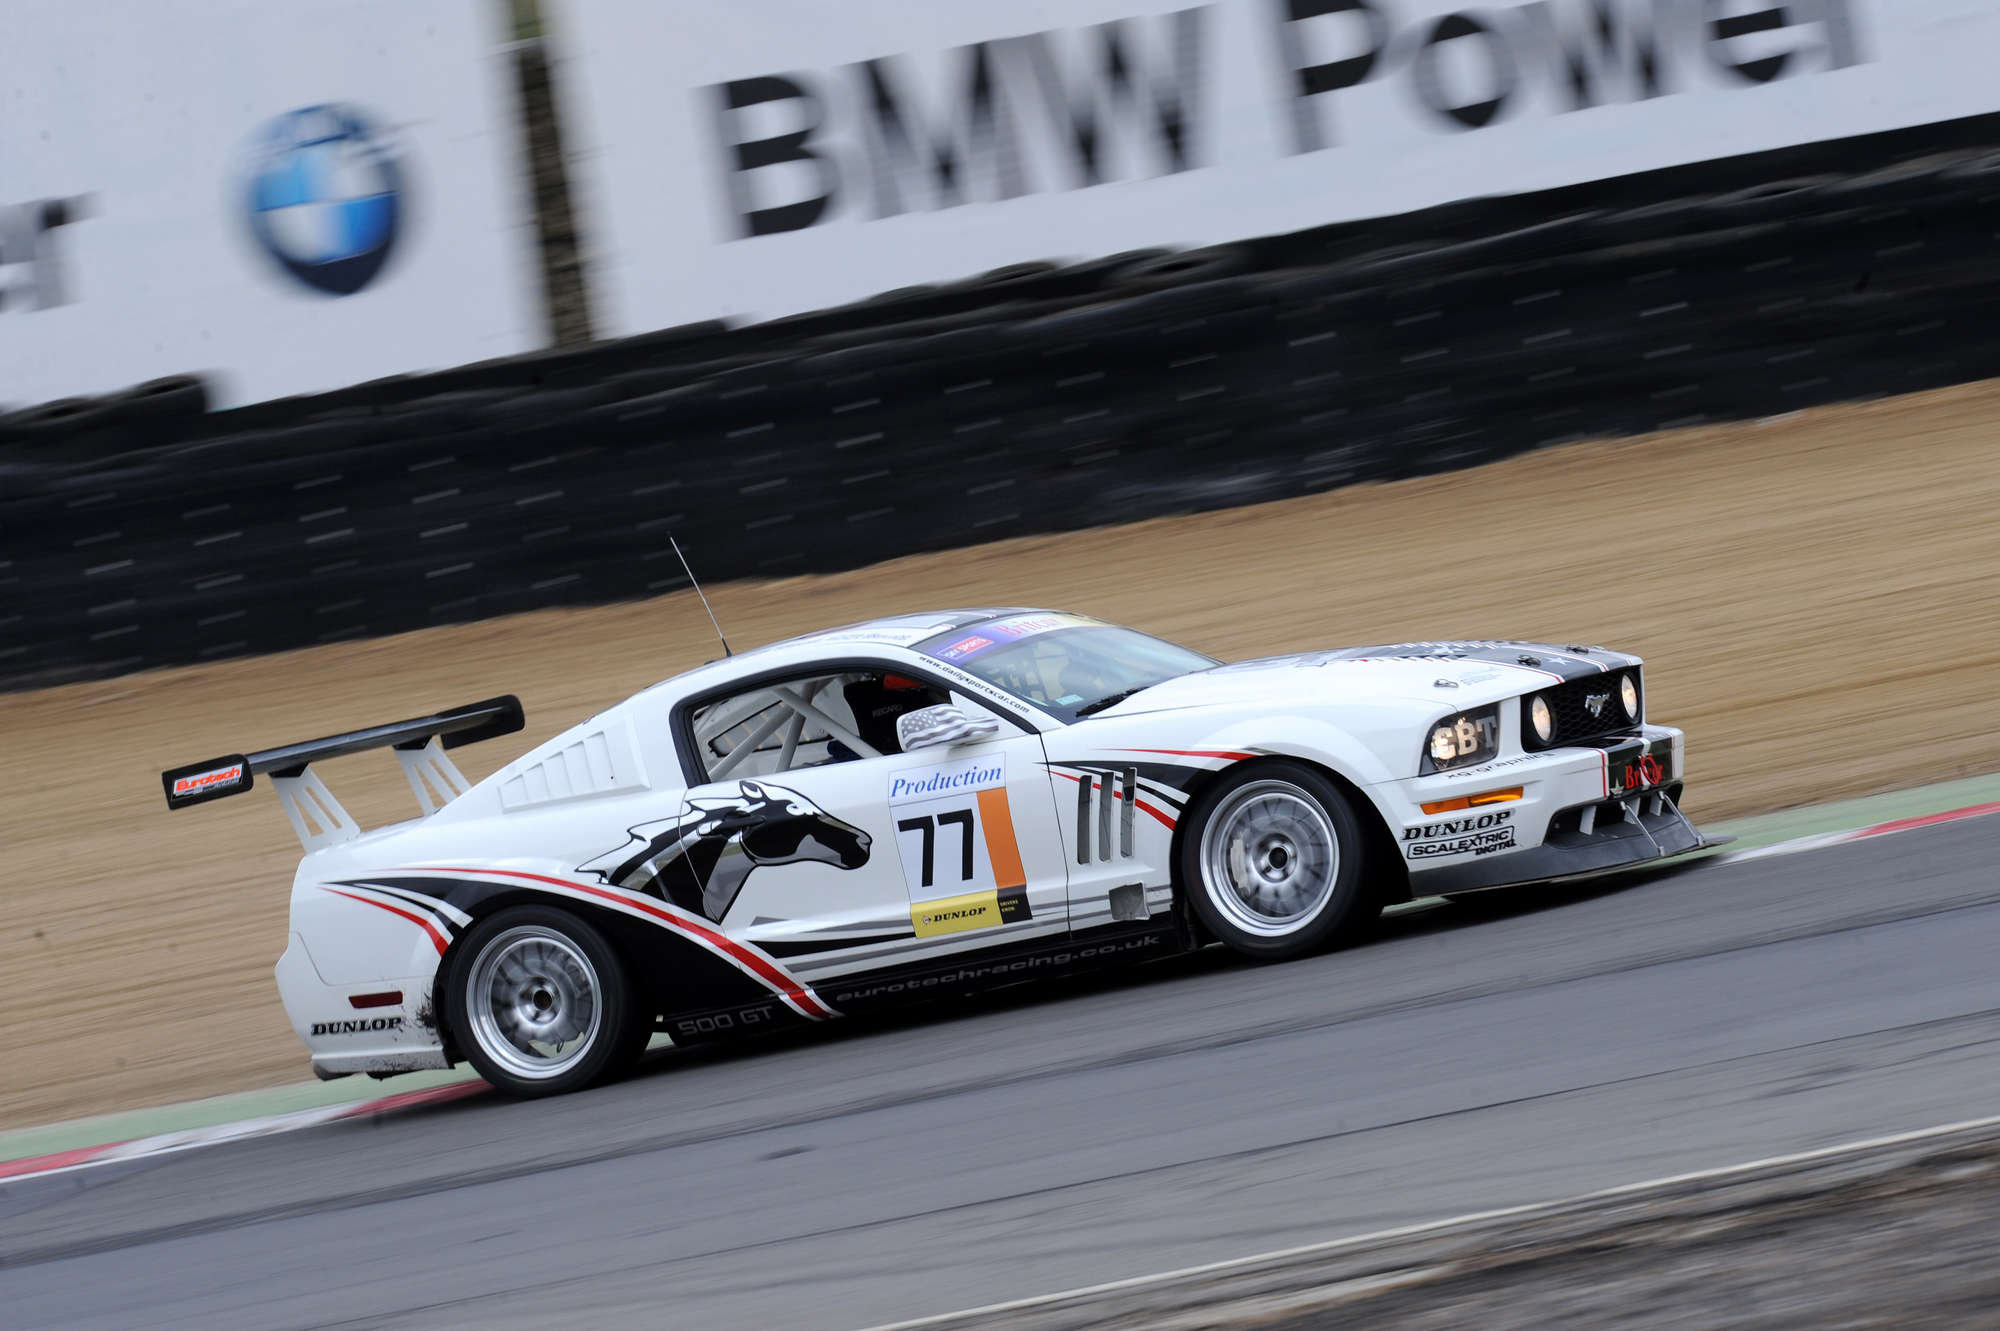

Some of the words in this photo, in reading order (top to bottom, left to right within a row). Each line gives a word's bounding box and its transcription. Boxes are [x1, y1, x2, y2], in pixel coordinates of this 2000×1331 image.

[692, 5, 1208, 243] BMW
[1270, 0, 1876, 158] Power
[919, 656, 1030, 713] www.dailysportscar.com
[176, 767, 241, 792] Eurotech
[891, 766, 1001, 798] Production
[1402, 811, 1511, 841] DUNLOP
[898, 808, 974, 887] 77
[1412, 830, 1509, 856] SCALEXTRIC
[1475, 839, 1517, 856] DIGITAL
[933, 907, 987, 923] DUNLOP
[836, 935, 1160, 1001] eurotechracing.co.uk
[311, 1017, 402, 1036] DUNLOP
[678, 1014, 734, 1036] 500
[740, 1006, 772, 1024] GT
